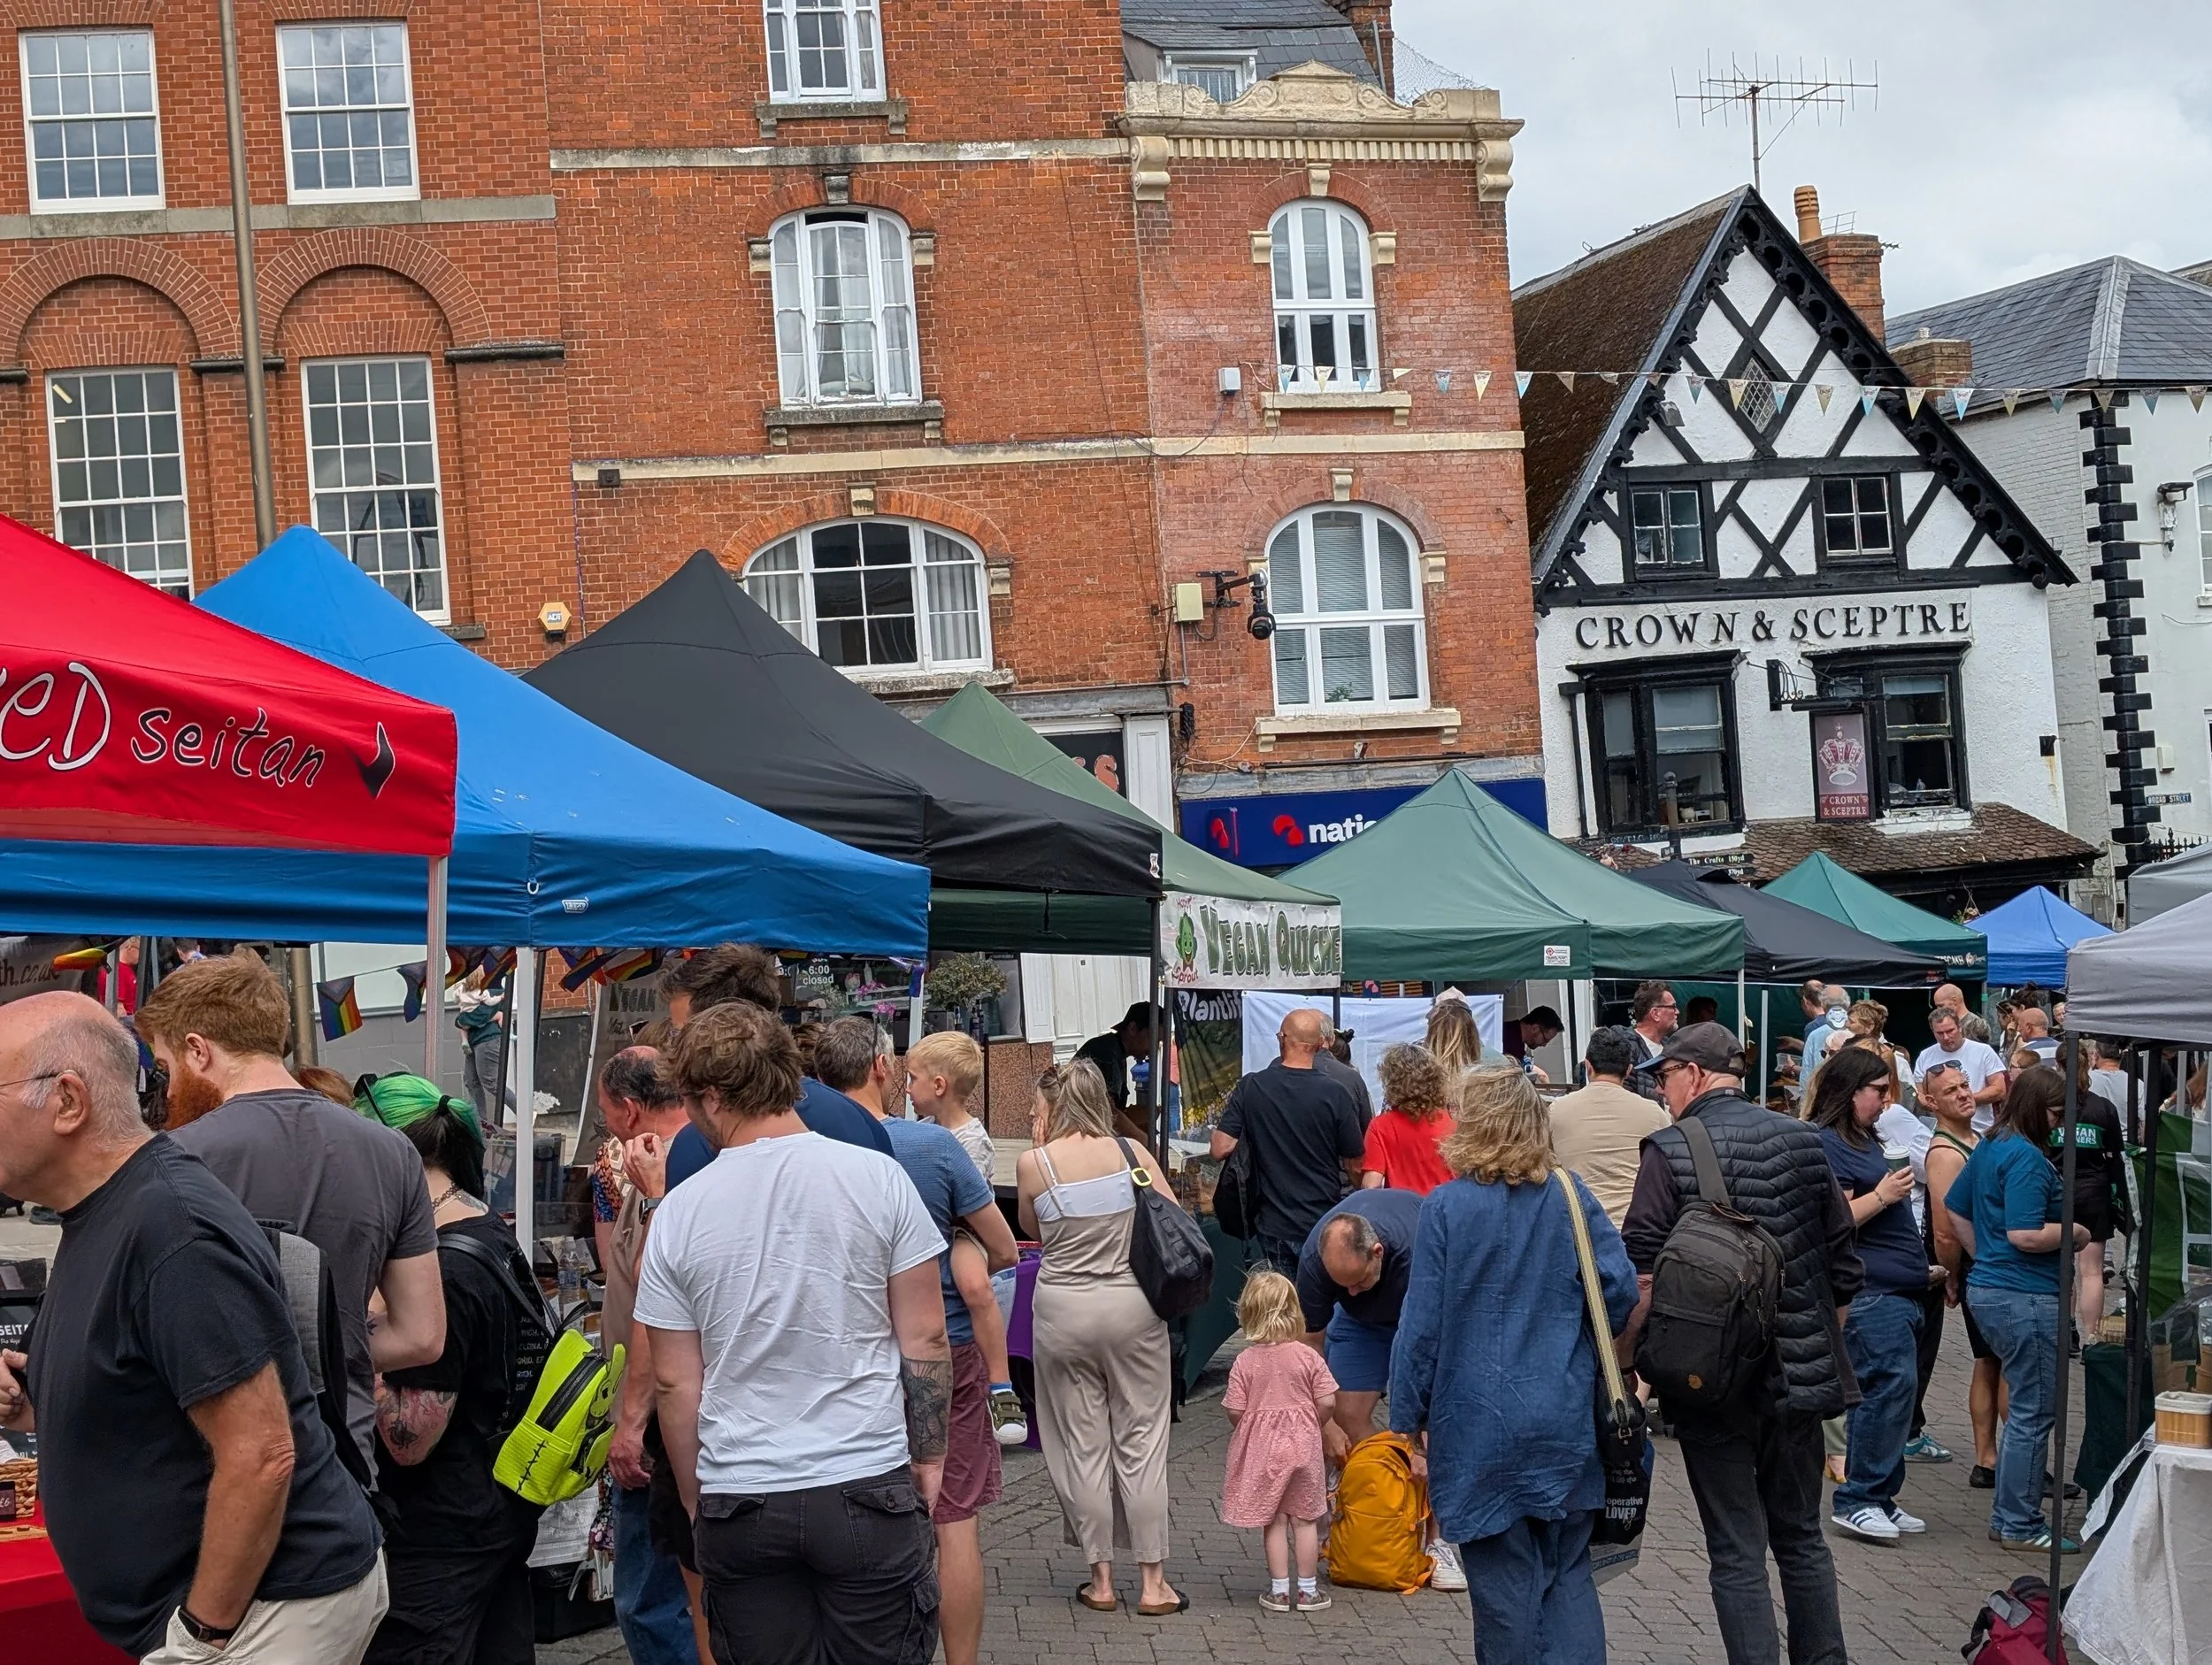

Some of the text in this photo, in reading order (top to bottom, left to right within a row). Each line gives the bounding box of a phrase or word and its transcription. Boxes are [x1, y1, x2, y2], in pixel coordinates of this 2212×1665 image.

[1575, 602, 1972, 649] CROWN & SCEPTRE
[0, 662, 325, 787] eD seitan
[1829, 795, 1860, 805] CROWN
[2169, 794, 2190, 803] STREET
[1824, 806, 1867, 816] & SCEPTRE
[808, 965, 830, 975] 6:00
[803, 974, 834, 985] closed
[1171, 966, 1199, 985] Sprout
[2057, 1126, 2096, 1139] VAN
[2057, 1136, 2097, 1145] RNERS
